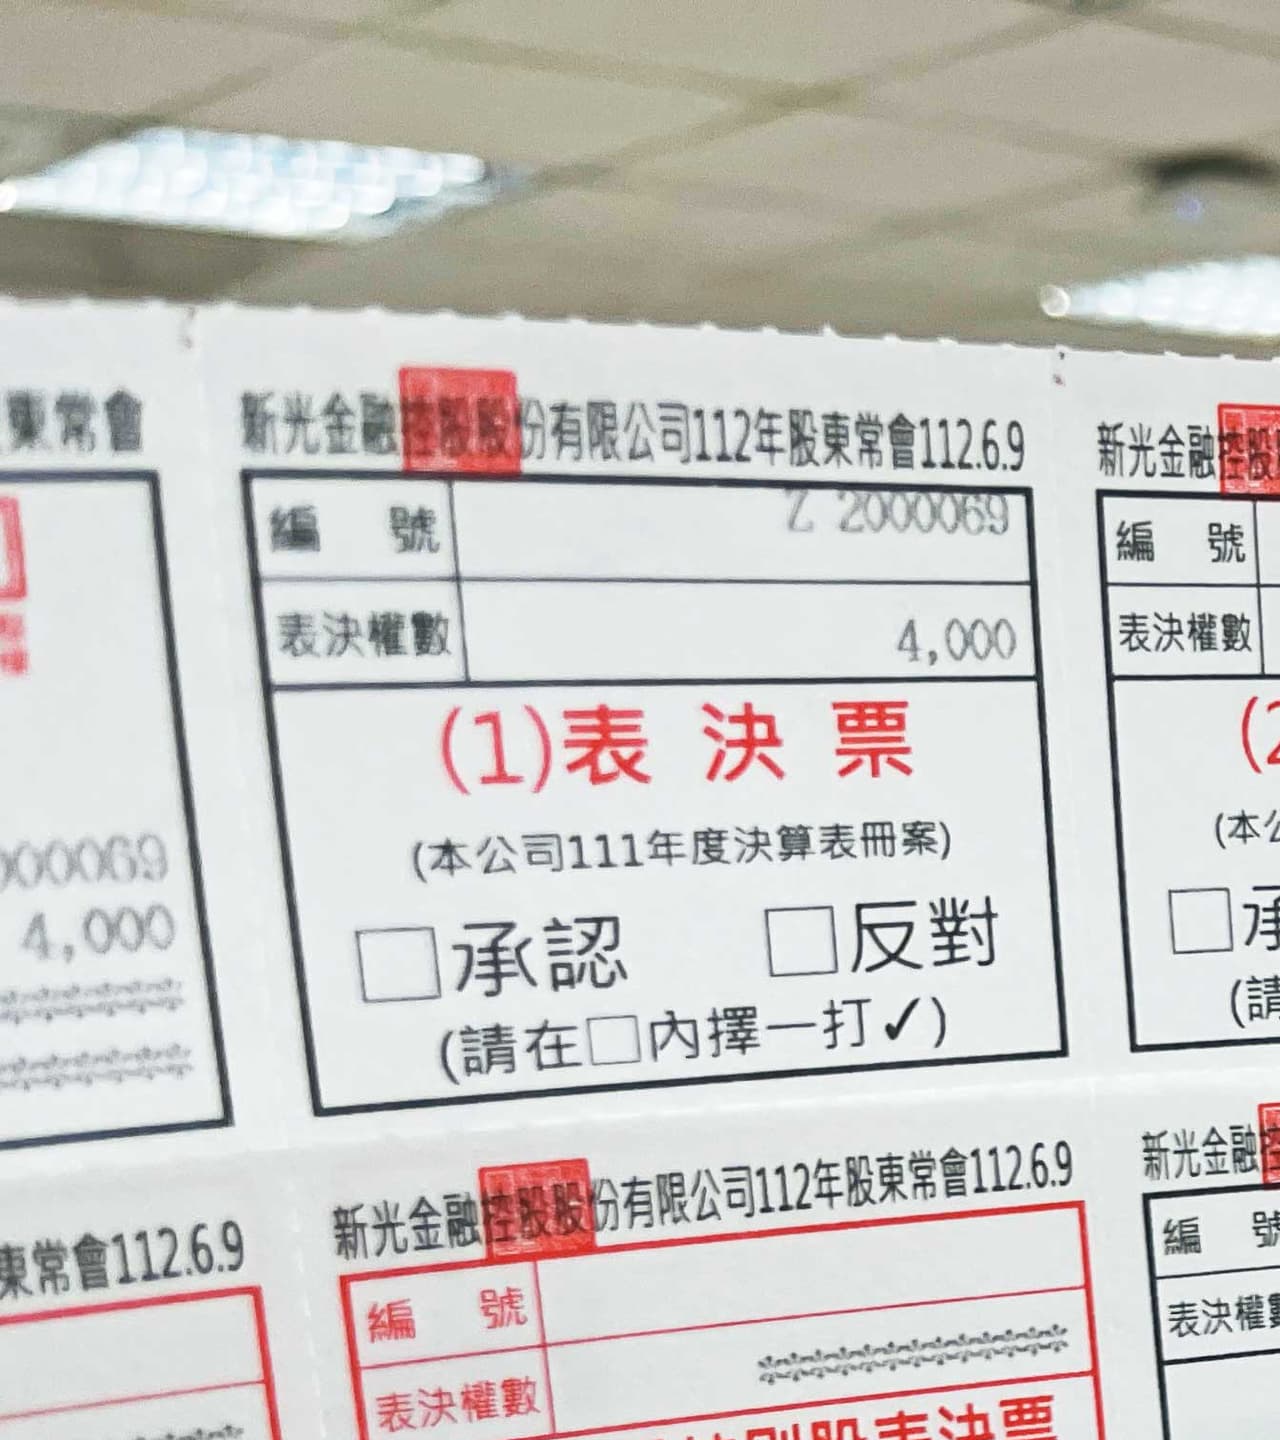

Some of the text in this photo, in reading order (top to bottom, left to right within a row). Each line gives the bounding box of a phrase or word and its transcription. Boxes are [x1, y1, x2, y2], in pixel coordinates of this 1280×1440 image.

[838, 493, 1010, 535] 2000069
[277, 613, 451, 659] 表決權數
[896, 619, 1017, 664] 4,000
[1120, 612, 1252, 653] 表決權數
[412, 820, 952, 881] (本公司111年度決算表冊案)
[22, 904, 175, 963] 4,000
[454, 917, 627, 996] 承認
[851, 896, 999, 974] 反對
[376, 1375, 541, 1433] 表決權數
